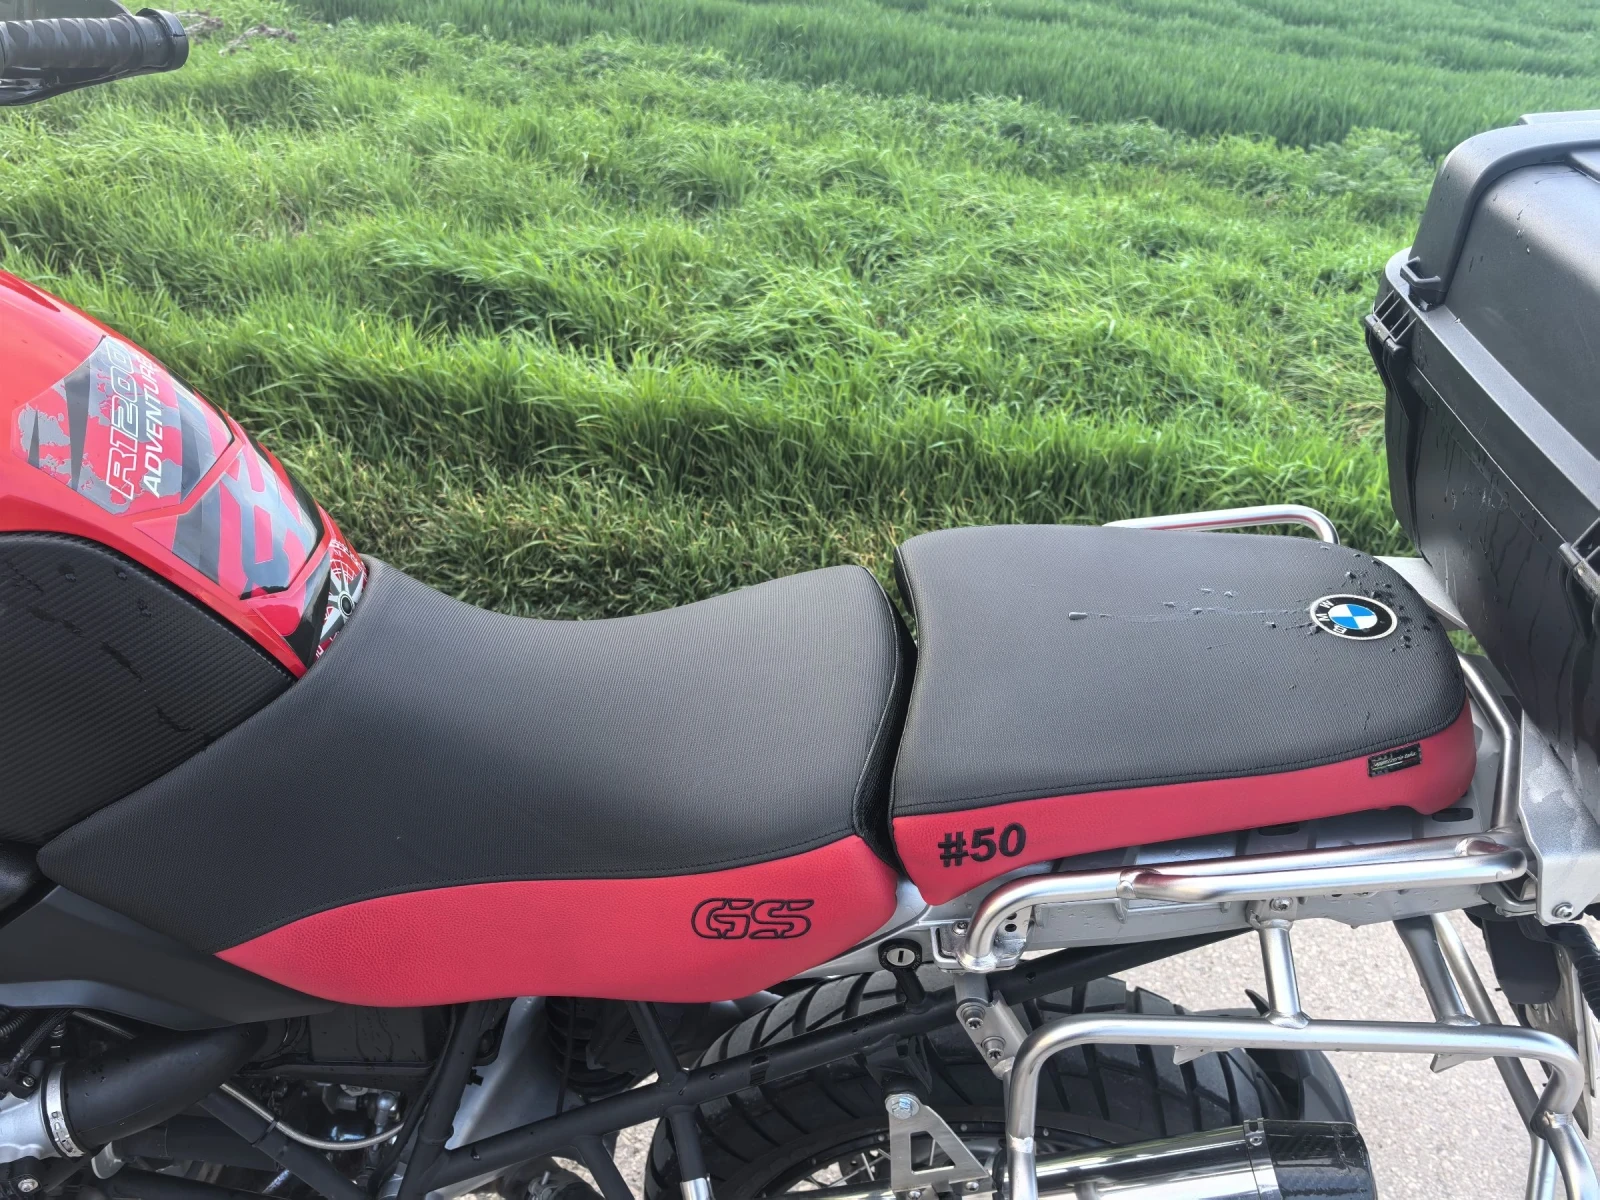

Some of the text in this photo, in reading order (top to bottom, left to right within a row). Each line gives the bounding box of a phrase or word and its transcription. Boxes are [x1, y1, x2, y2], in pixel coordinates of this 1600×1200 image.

[106, 341, 137, 500] R1200
[138, 353, 163, 498] ADVENTURE
[938, 822, 1026, 868] #50
[691, 897, 815, 940] GS
